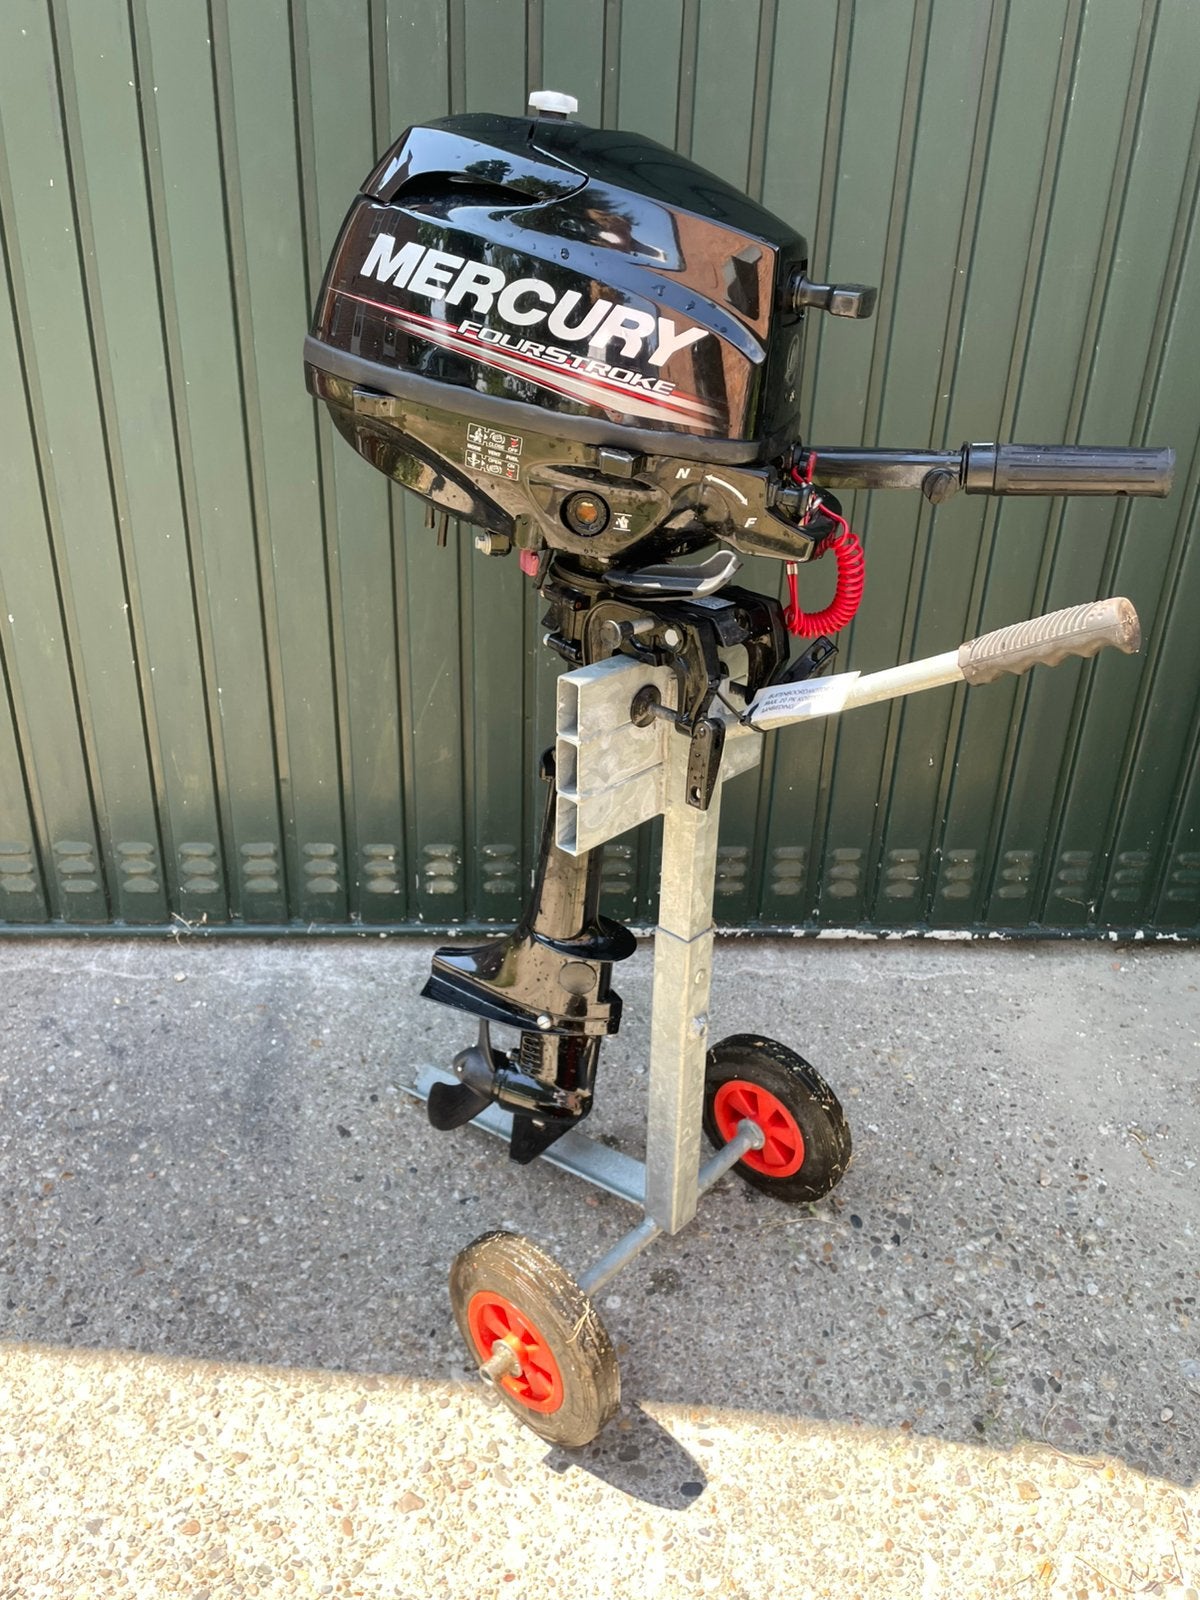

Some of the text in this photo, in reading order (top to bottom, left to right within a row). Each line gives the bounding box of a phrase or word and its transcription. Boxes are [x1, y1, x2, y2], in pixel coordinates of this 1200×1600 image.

[360, 232, 709, 367] MERCURY
[456, 319, 676, 396] FOURSTROKE
[488, 449, 501, 457] VENT
[506, 454, 519, 462] FUEL
[488, 457, 502, 465] OPEN
[675, 467, 691, 479] N
[744, 517, 758, 528] F
